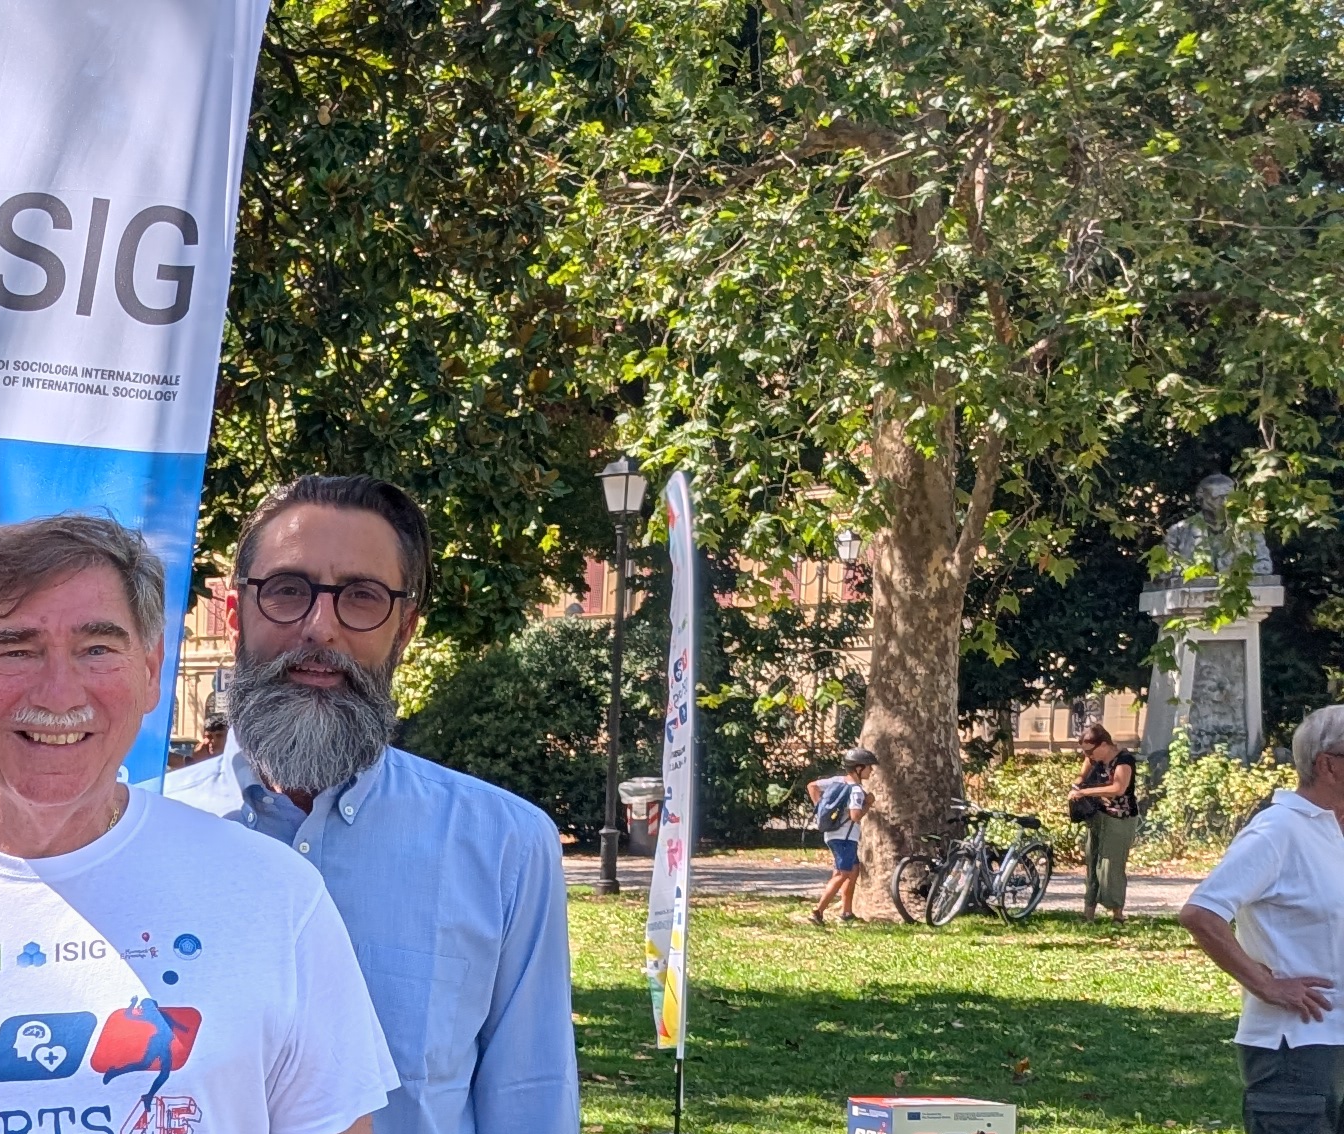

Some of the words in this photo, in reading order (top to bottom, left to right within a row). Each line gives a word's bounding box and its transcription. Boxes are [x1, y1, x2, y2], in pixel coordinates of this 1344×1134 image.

[12, 360, 79, 378] SOCIOLOGIA
[81, 367, 181, 386] INTERNAZIONALE
[2, 375, 19, 387] OF
[22, 376, 109, 397] INTERNATIONAL
[112, 386, 179, 402] SOCIOLOGY
[54, 940, 107, 963] ISIG
